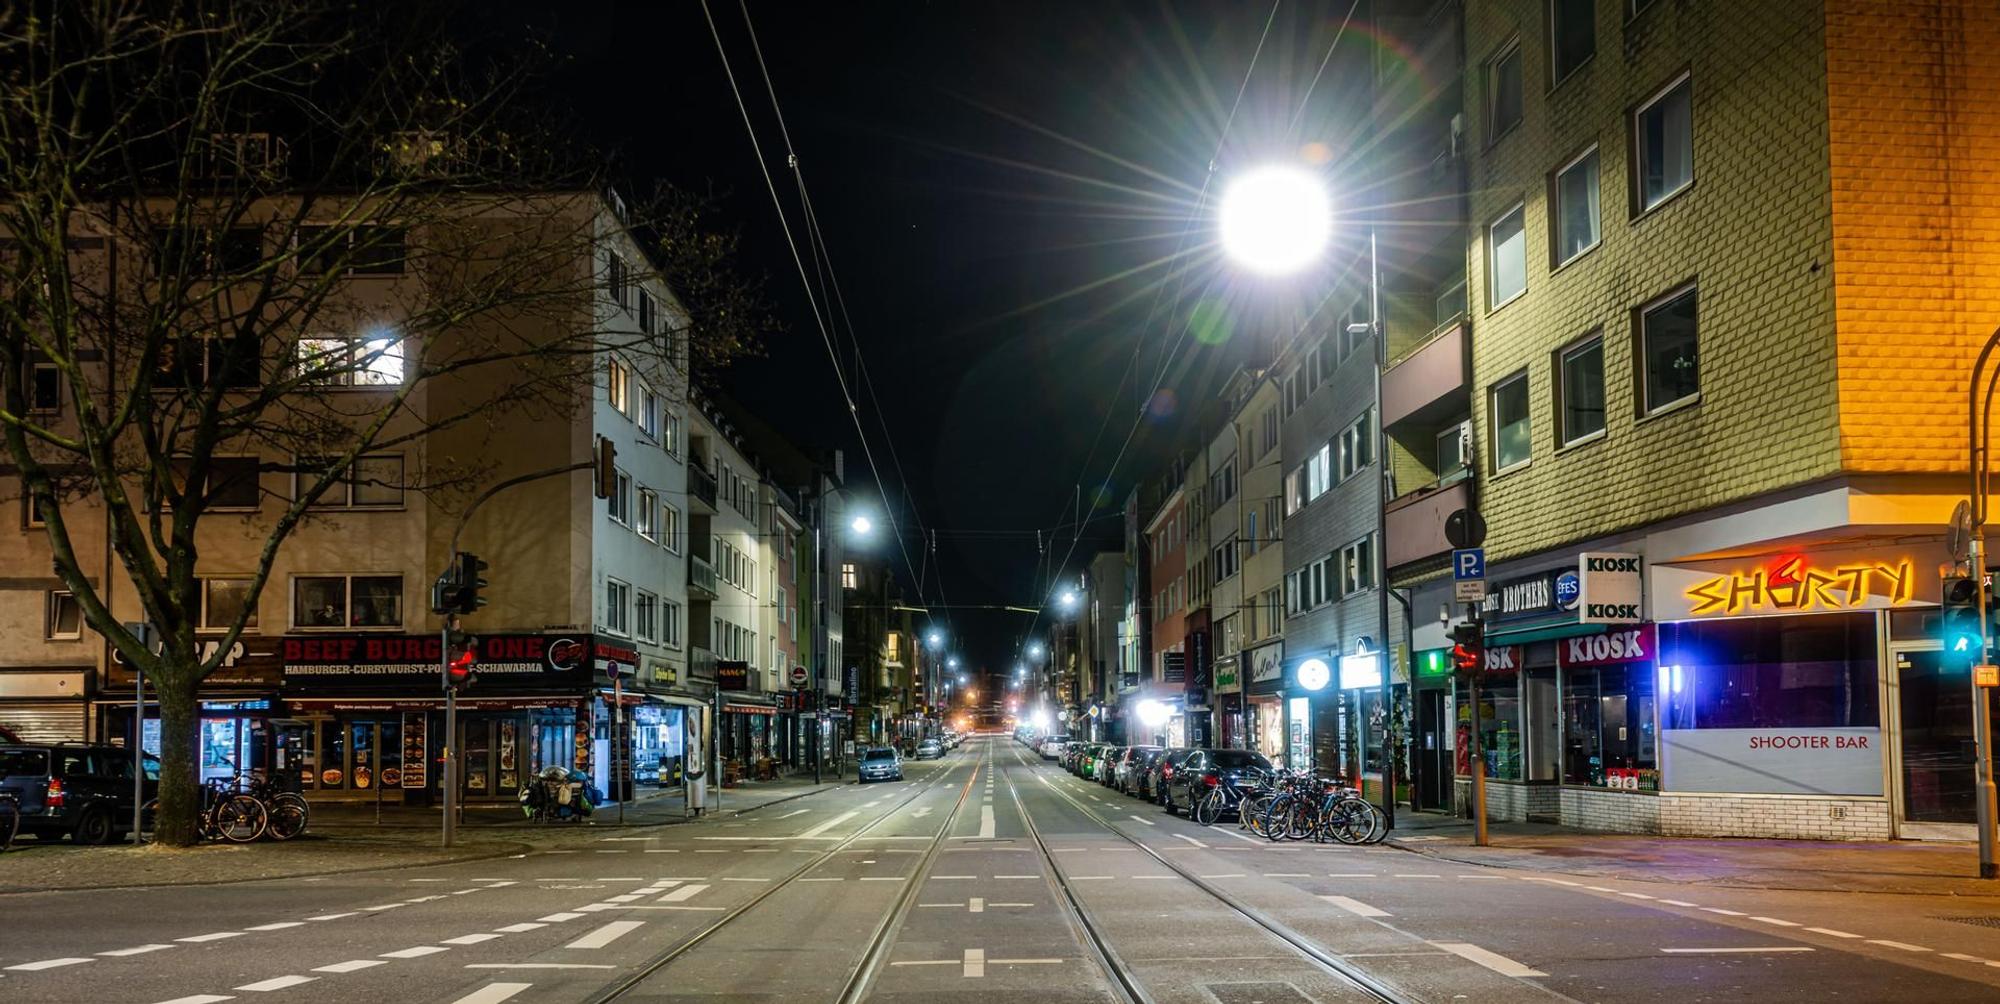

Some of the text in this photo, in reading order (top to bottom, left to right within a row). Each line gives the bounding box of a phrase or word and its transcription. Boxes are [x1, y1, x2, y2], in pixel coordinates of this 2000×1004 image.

[1460, 553, 1478, 577] P
[1587, 557, 1638, 573] KIOSK
[1503, 579, 1549, 613] BROTHERS
[1557, 580, 1577, 594] EFES
[1686, 558, 1914, 613] SHORTY
[1587, 604, 1638, 618] KIOSK
[284, 639, 357, 661] BEEF
[487, 638, 544, 659] ONE
[1568, 630, 1644, 664] KIOSK
[1750, 735, 1869, 750] SHOOTER BAR
